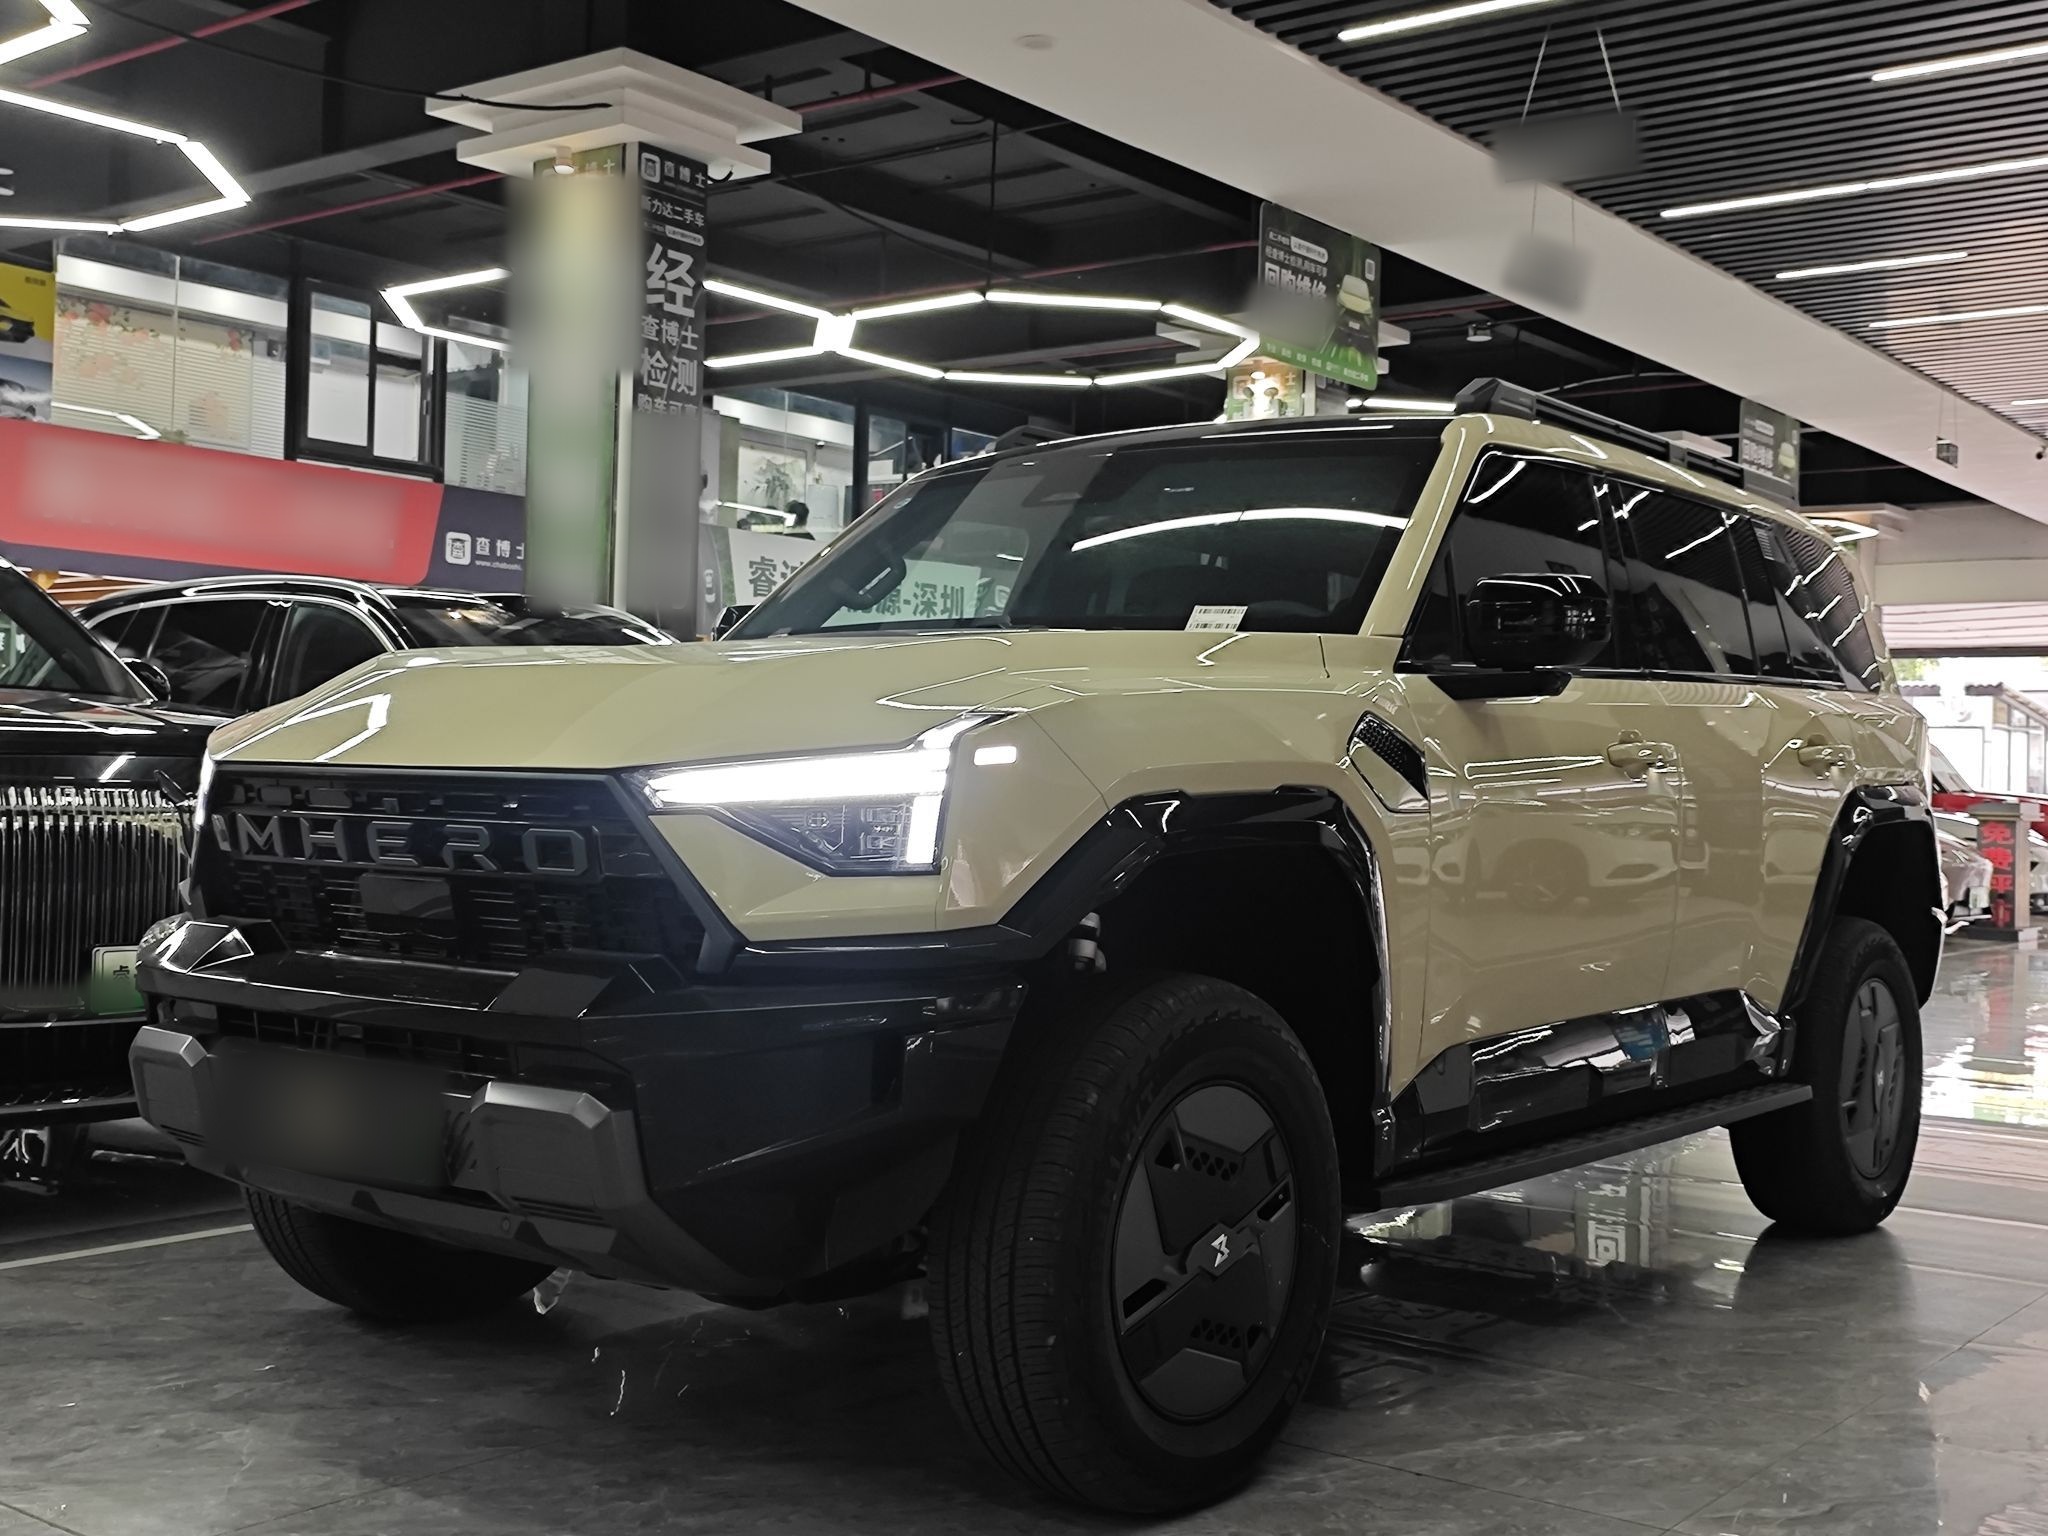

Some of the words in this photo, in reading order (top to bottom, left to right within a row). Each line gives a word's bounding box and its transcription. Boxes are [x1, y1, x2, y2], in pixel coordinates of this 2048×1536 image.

[646, 242, 696, 318] 经
[641, 314, 699, 350] 查博士
[640, 347, 698, 396] 检测
[236, 812, 588, 878] MHERO
